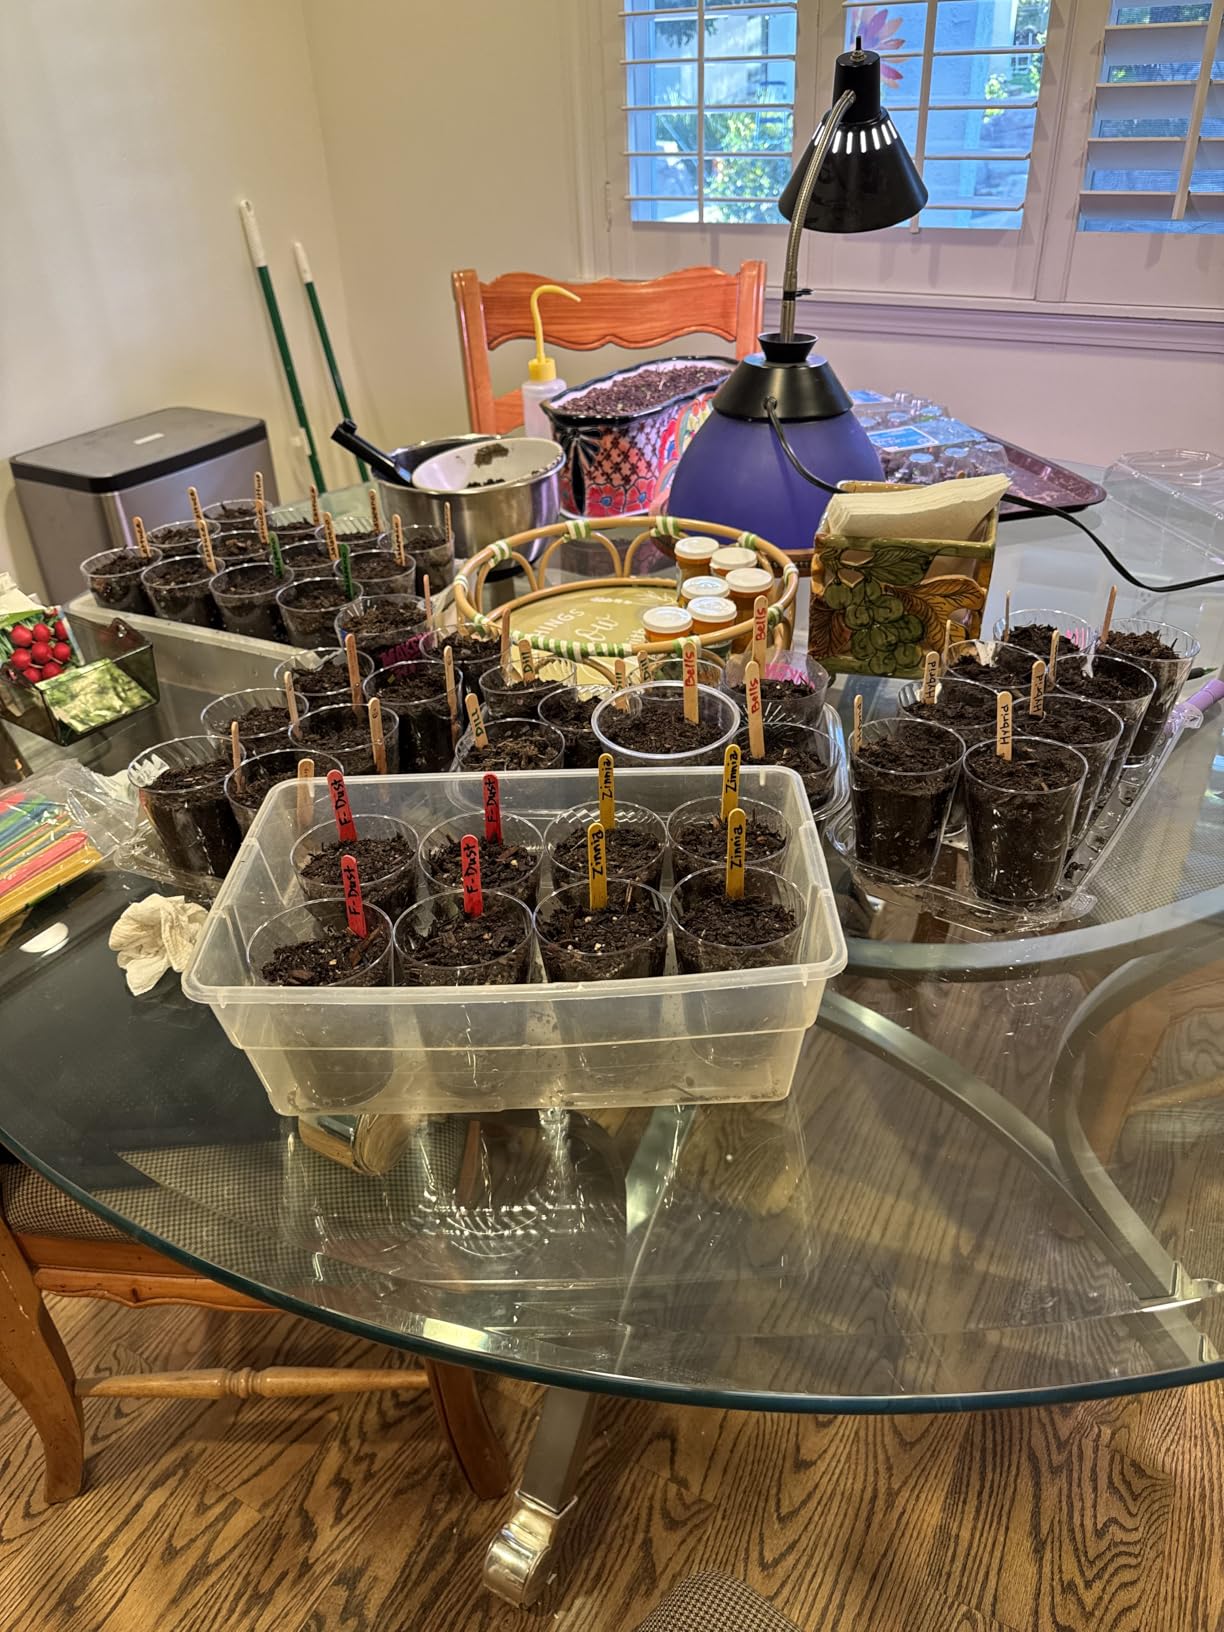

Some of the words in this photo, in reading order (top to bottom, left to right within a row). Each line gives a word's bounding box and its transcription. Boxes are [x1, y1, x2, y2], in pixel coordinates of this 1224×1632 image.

[533, 608, 585, 637] HINGS
[755, 607, 766, 641] Bells
[520, 652, 533, 673] Dill
[685, 651, 695, 687] Bells
[925, 660, 937, 699] Hybrid
[748, 677, 760, 714] Bells
[1032, 674, 1044, 713] Hybrid
[1000, 705, 1011, 745] Hybrid
[600, 758, 613, 800] Zinnia
[725, 750, 739, 793] Zinnia
[590, 830, 604, 879] Zinnia
[730, 824, 743, 870] Zinnia
